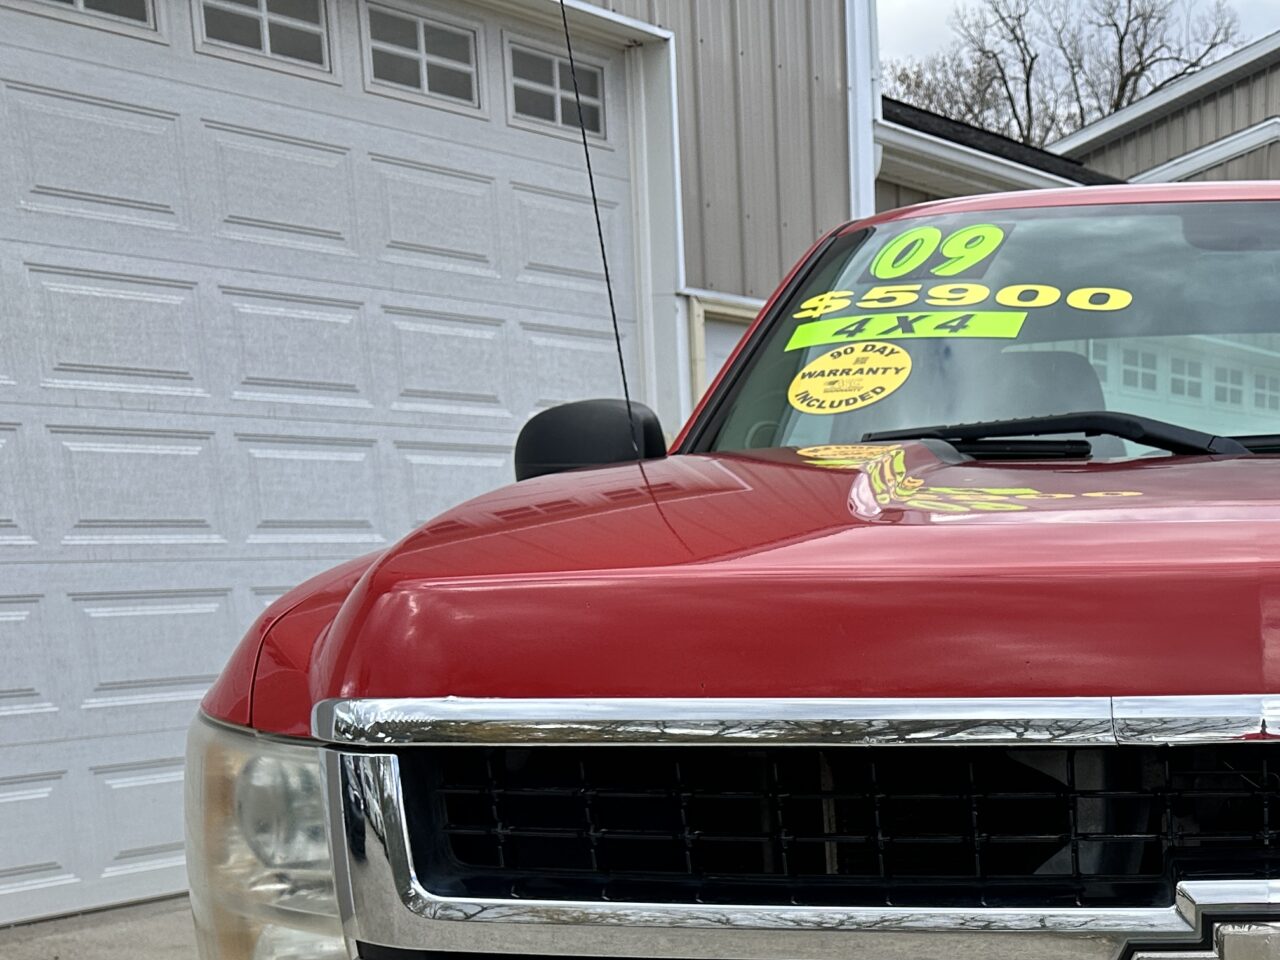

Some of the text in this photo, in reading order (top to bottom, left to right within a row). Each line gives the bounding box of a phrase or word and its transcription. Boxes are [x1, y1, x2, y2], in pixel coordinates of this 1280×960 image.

[870, 224, 1005, 280] 09
[792, 283, 1134, 319] $5900
[831, 313, 977, 339] 4X4
[830, 344, 900, 359] 90 DAY
[800, 367, 906, 380] WARRANTY
[795, 386, 886, 409] INCLUDED
